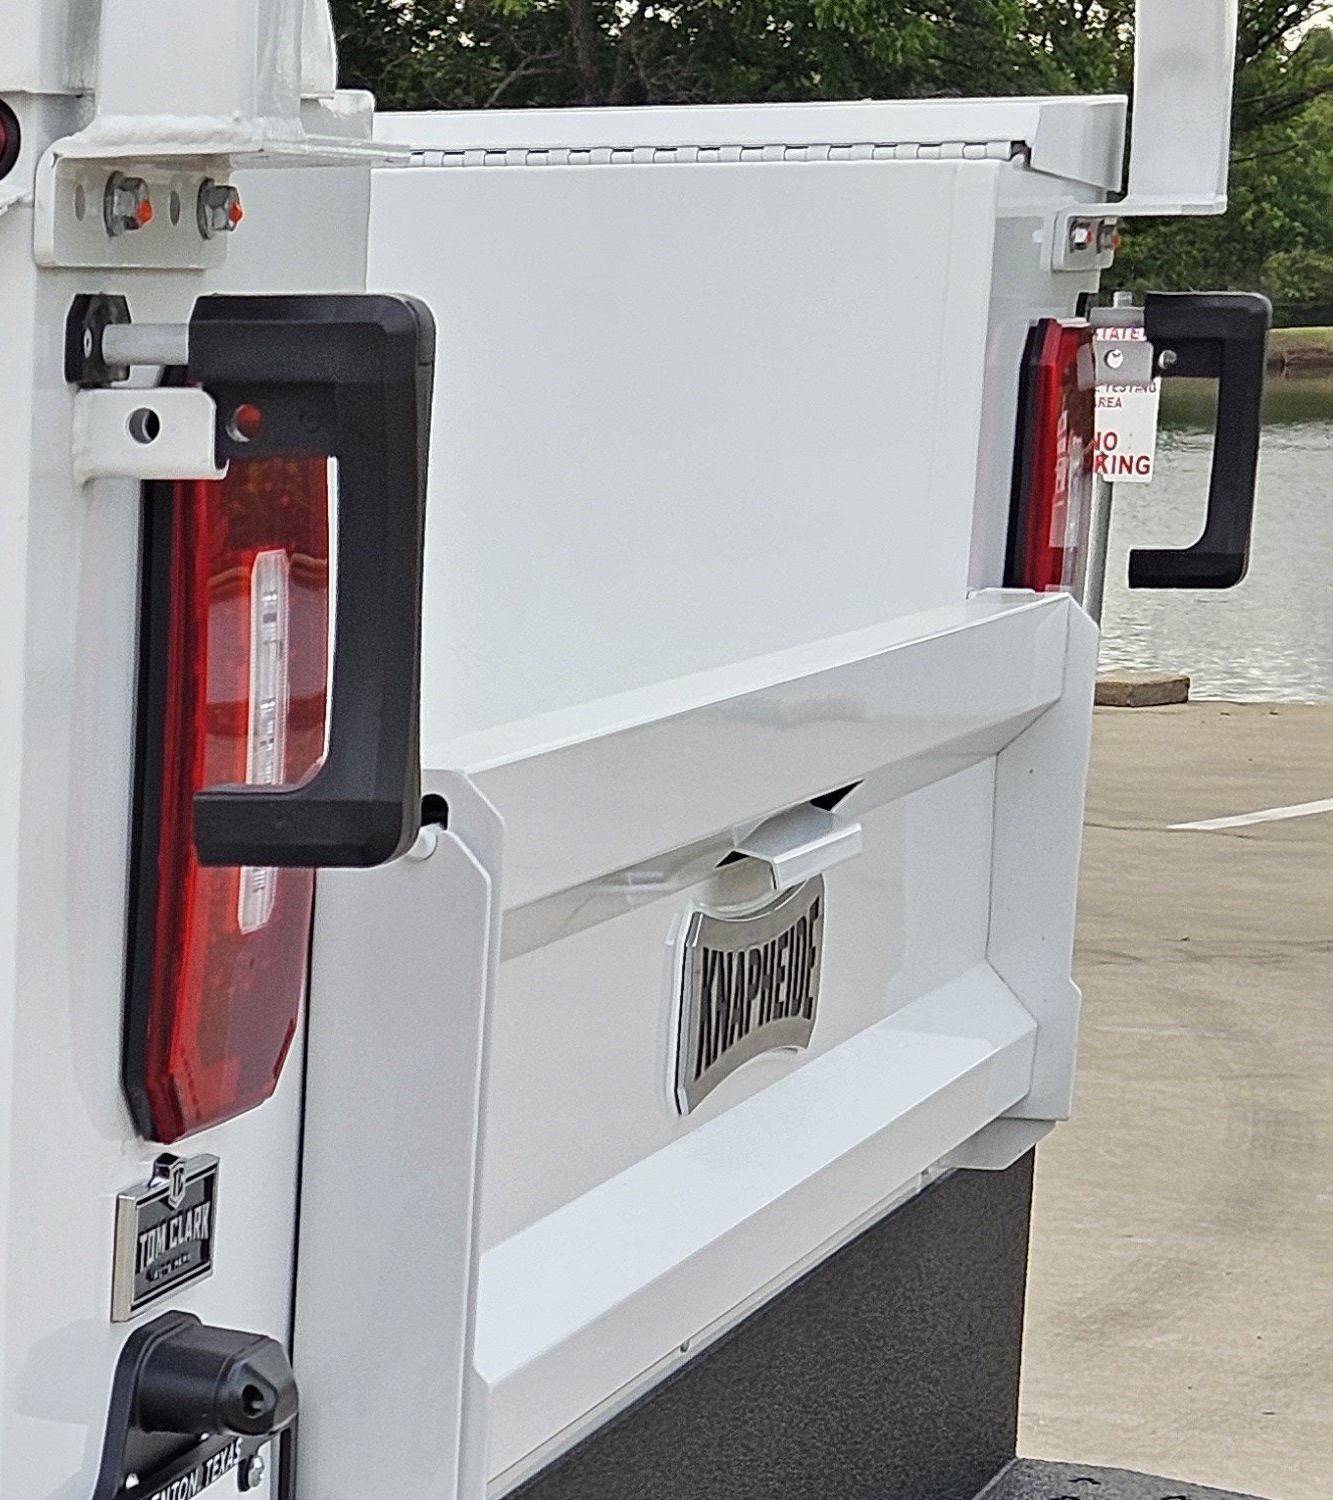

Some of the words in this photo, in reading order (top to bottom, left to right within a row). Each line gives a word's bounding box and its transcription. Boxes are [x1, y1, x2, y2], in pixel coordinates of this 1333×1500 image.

[1099, 327, 1140, 340] TATE
[1096, 396, 1122, 407] REA
[694, 896, 821, 1082] KNAPHEIDE
[139, 1222, 167, 1272] TOM
[169, 1200, 211, 1250] CLARK
[204, 1436, 243, 1487] TEXAS
